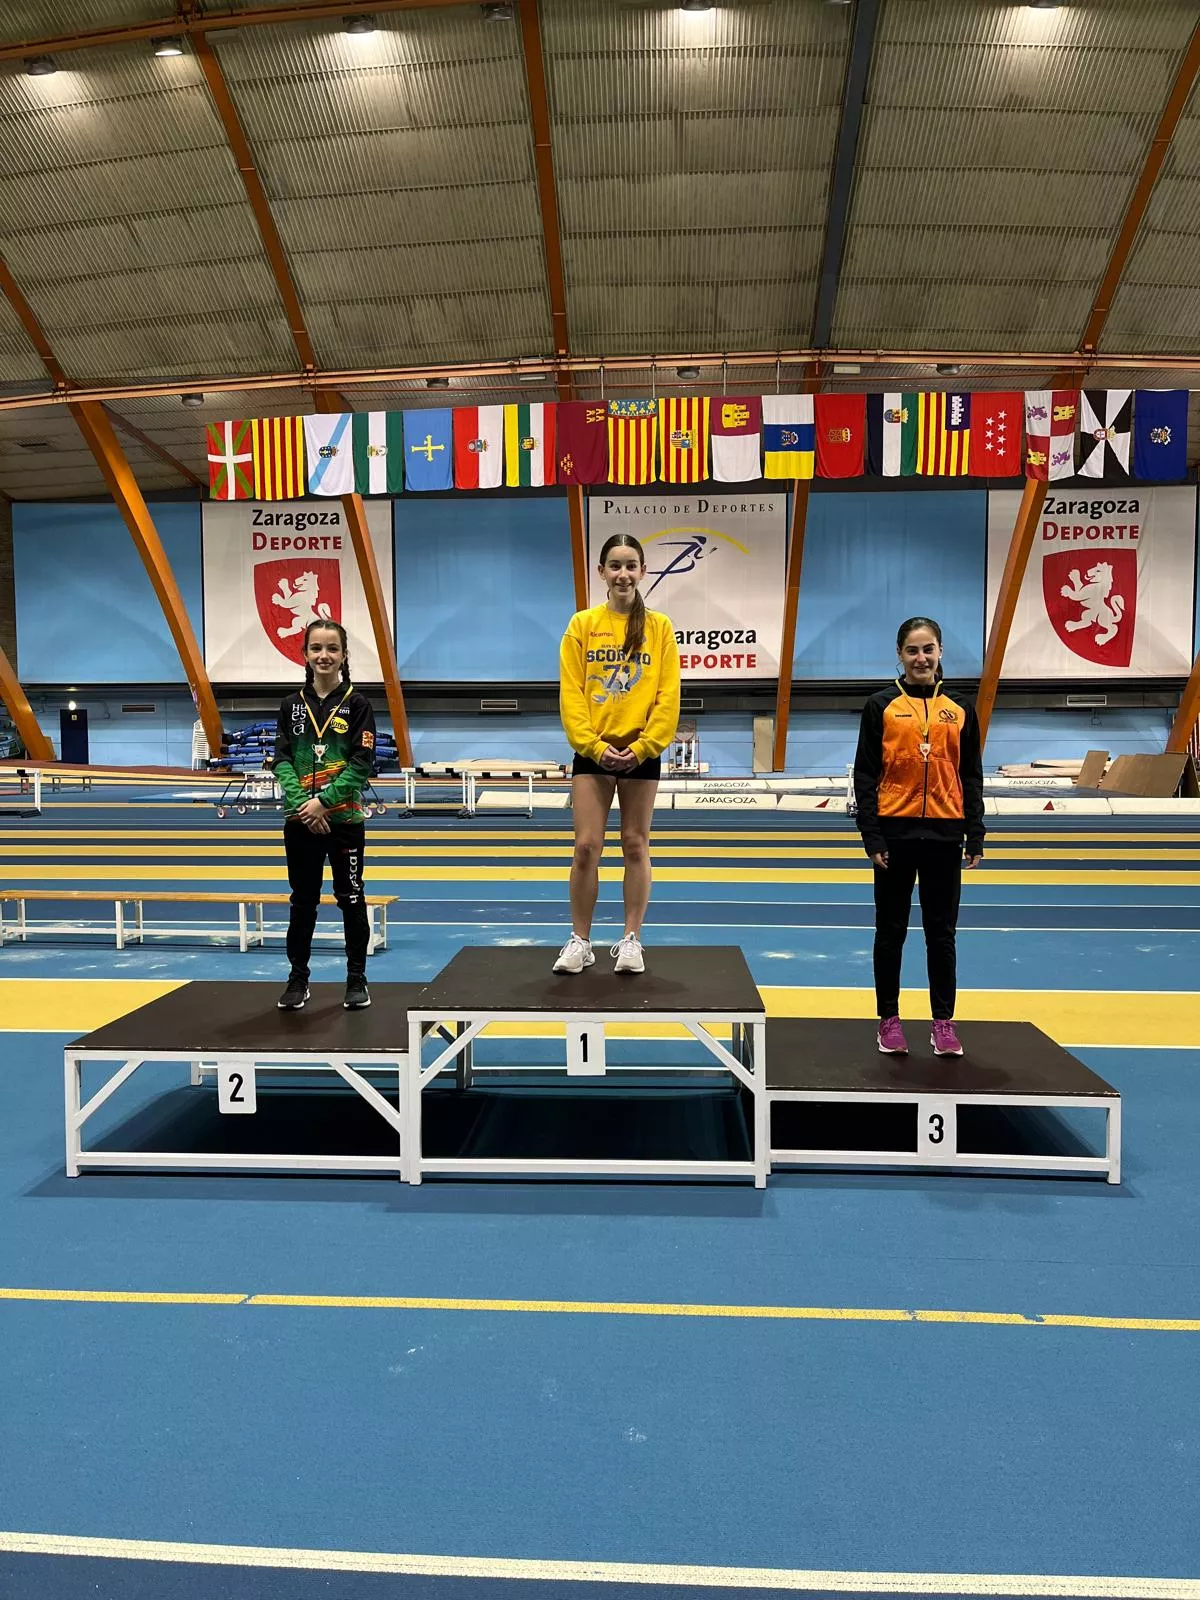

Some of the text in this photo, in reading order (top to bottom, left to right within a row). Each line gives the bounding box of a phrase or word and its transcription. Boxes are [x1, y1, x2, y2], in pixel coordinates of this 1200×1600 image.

[603, 499, 775, 514] PALACIO DE DEPORTES
[1043, 497, 1140, 520] Zaragoza
[252, 509, 340, 531] Zaragoza
[1042, 521, 1139, 540] DEPORTE
[252, 532, 342, 550] DEPORTE
[675, 629, 757, 650] aragoza
[680, 653, 757, 669] EPORTE
[695, 796, 758, 804] ZARAGOZA
[580, 1033, 588, 1062] 1
[229, 1073, 244, 1102] 2
[929, 1114, 944, 1144] 3
